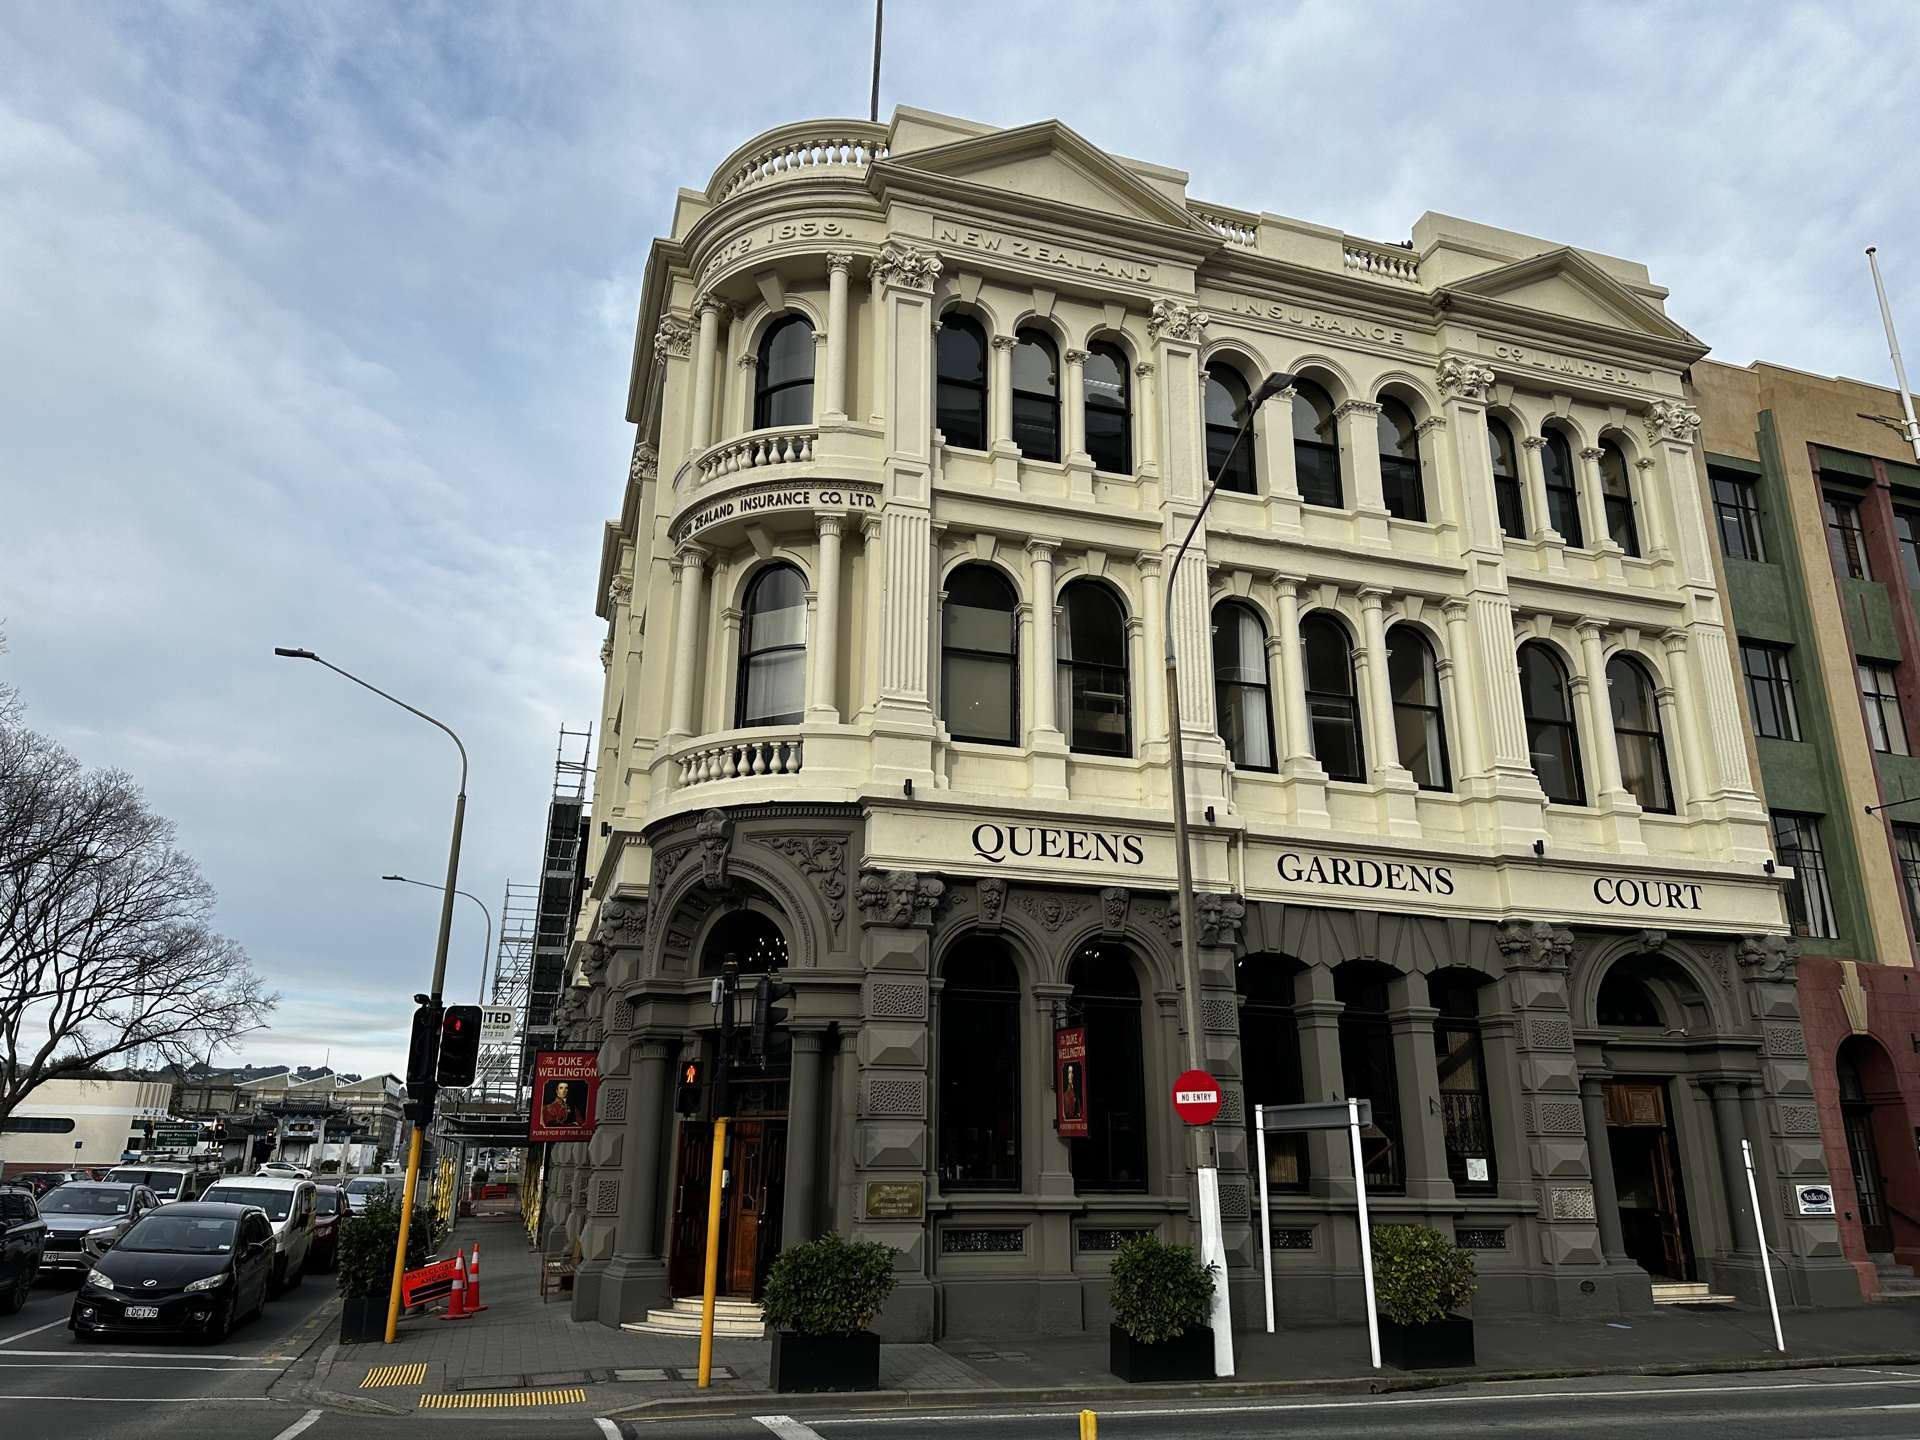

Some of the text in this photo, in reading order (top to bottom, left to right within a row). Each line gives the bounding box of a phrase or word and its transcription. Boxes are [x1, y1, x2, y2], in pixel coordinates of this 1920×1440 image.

[941, 228, 1152, 282] NEW ZEALAND
[1231, 296, 1404, 345] INSURANCE
[695, 502, 734, 529] ZEALAND
[740, 491, 810, 512] INSURANCE
[849, 493, 876, 508] LTD.
[971, 823, 1144, 865] QUEENS
[1277, 853, 1455, 895] GARDENS
[1593, 878, 1703, 910] COURT
[483, 1012, 511, 1023] ITED
[542, 1056, 594, 1067] The DUKE of
[1058, 1046, 1086, 1059] WELLINGTON
[538, 1067, 598, 1077] WELLINGTON
[1181, 1093, 1212, 1101] NO ENTRY
